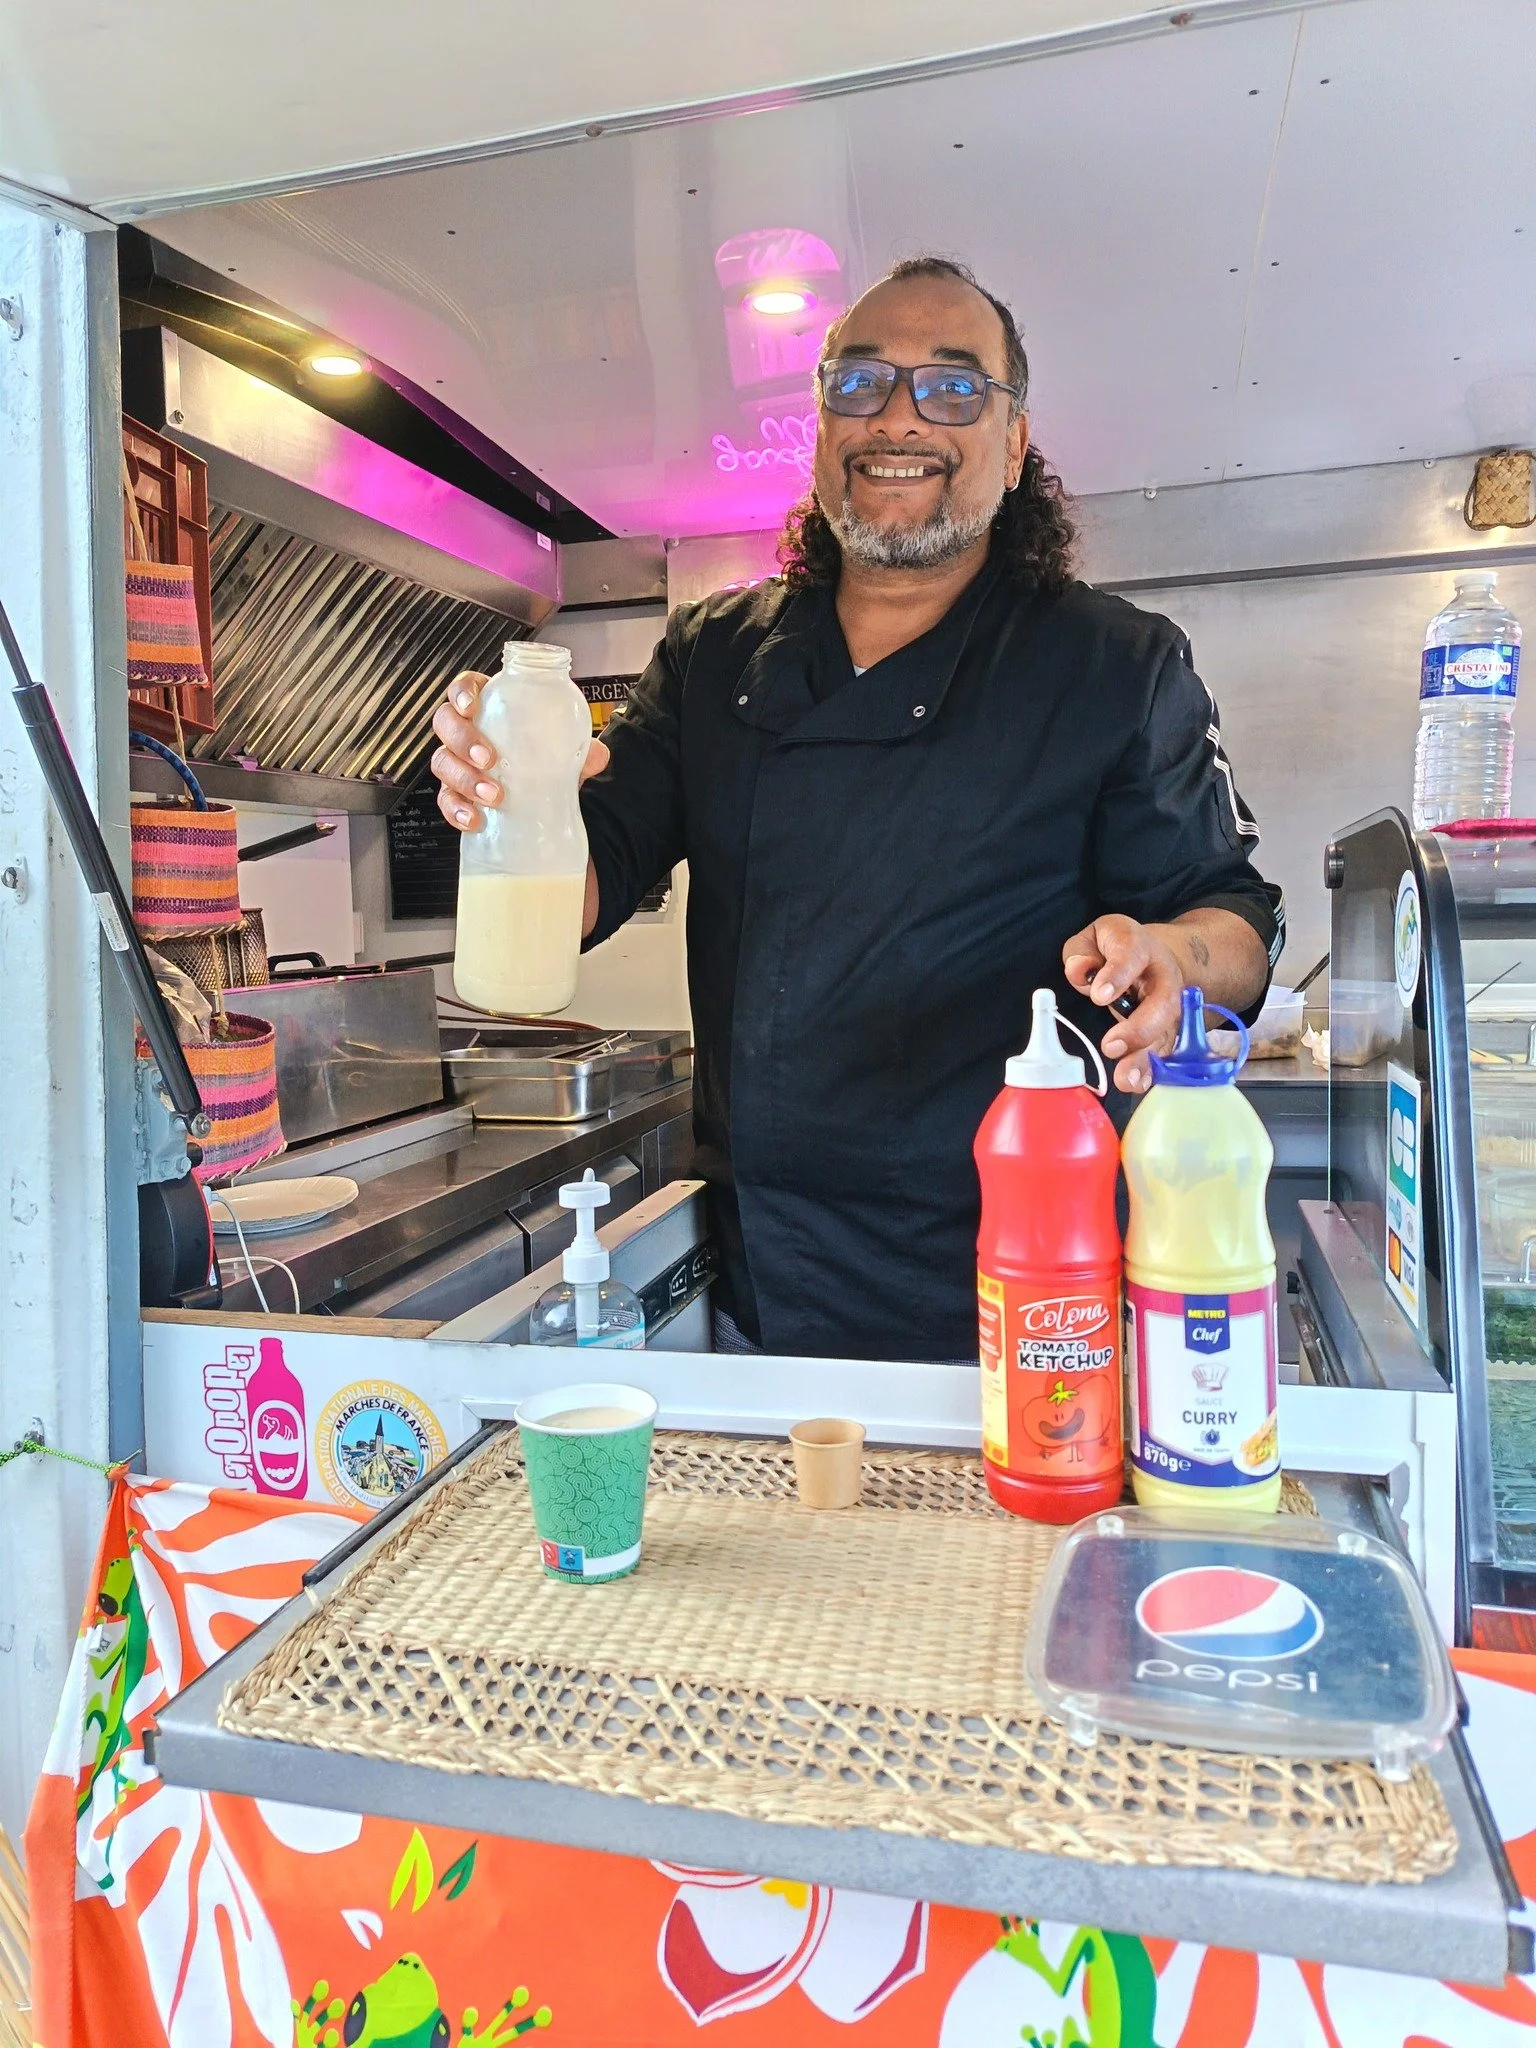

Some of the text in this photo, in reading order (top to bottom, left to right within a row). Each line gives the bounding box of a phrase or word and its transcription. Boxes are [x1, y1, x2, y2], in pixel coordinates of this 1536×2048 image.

[1403, 1257, 1415, 1289] VISA
[1025, 1301, 1107, 1331] Colona
[1187, 1309, 1226, 1319] METRO
[1192, 1327, 1223, 1344] Chef
[1021, 1341, 1087, 1353] TOMATO
[1020, 1348, 1112, 1369] KETCHUP
[382, 1385, 408, 1404] DES
[1195, 1396, 1223, 1406] SAUCE
[335, 1398, 429, 1451] MARCHES DE FRANCE
[1182, 1410, 1238, 1425] CURRY
[1136, 1659, 1318, 1694] pepsi
